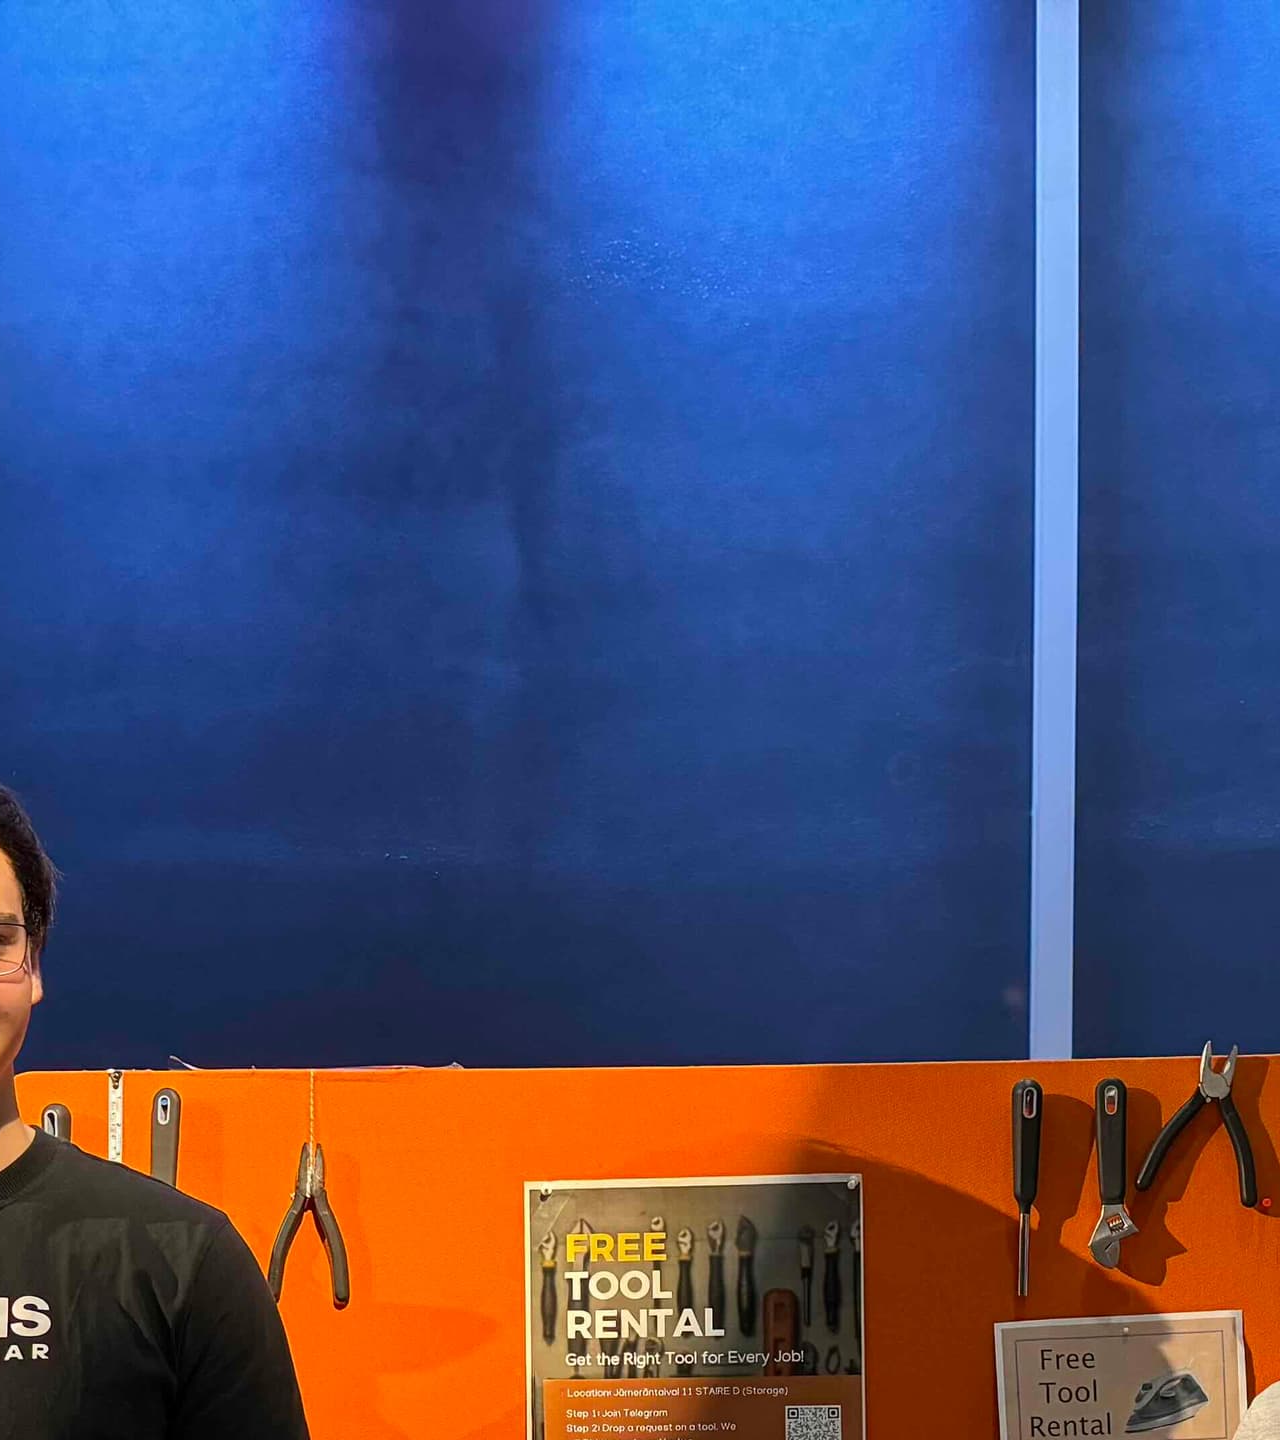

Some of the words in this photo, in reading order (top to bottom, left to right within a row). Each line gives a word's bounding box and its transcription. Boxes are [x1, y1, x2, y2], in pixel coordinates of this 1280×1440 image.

[566, 1233, 668, 1262] FREE
[565, 1270, 673, 1300] TOOL
[566, 1308, 725, 1339] RENTAL
[565, 1353, 592, 1367] Get
[597, 1353, 620, 1366] the
[623, 1352, 661, 1369] Right
[665, 1351, 698, 1365] Tool
[702, 1350, 724, 1365] for
[728, 1350, 770, 1369] Every
[774, 1350, 804, 1364] Job!
[1039, 1349, 1096, 1371] Free
[742, 1386, 789, 1397] (Storage)
[1039, 1379, 1098, 1404] Tool
[566, 1408, 589, 1420] Step
[601, 1408, 621, 1418] Join
[623, 1408, 669, 1420] Telegram
[1030, 1412, 1112, 1438] Rental
[566, 1424, 589, 1435] Step
[602, 1424, 626, 1435] Drop
[635, 1424, 673, 1435] request
